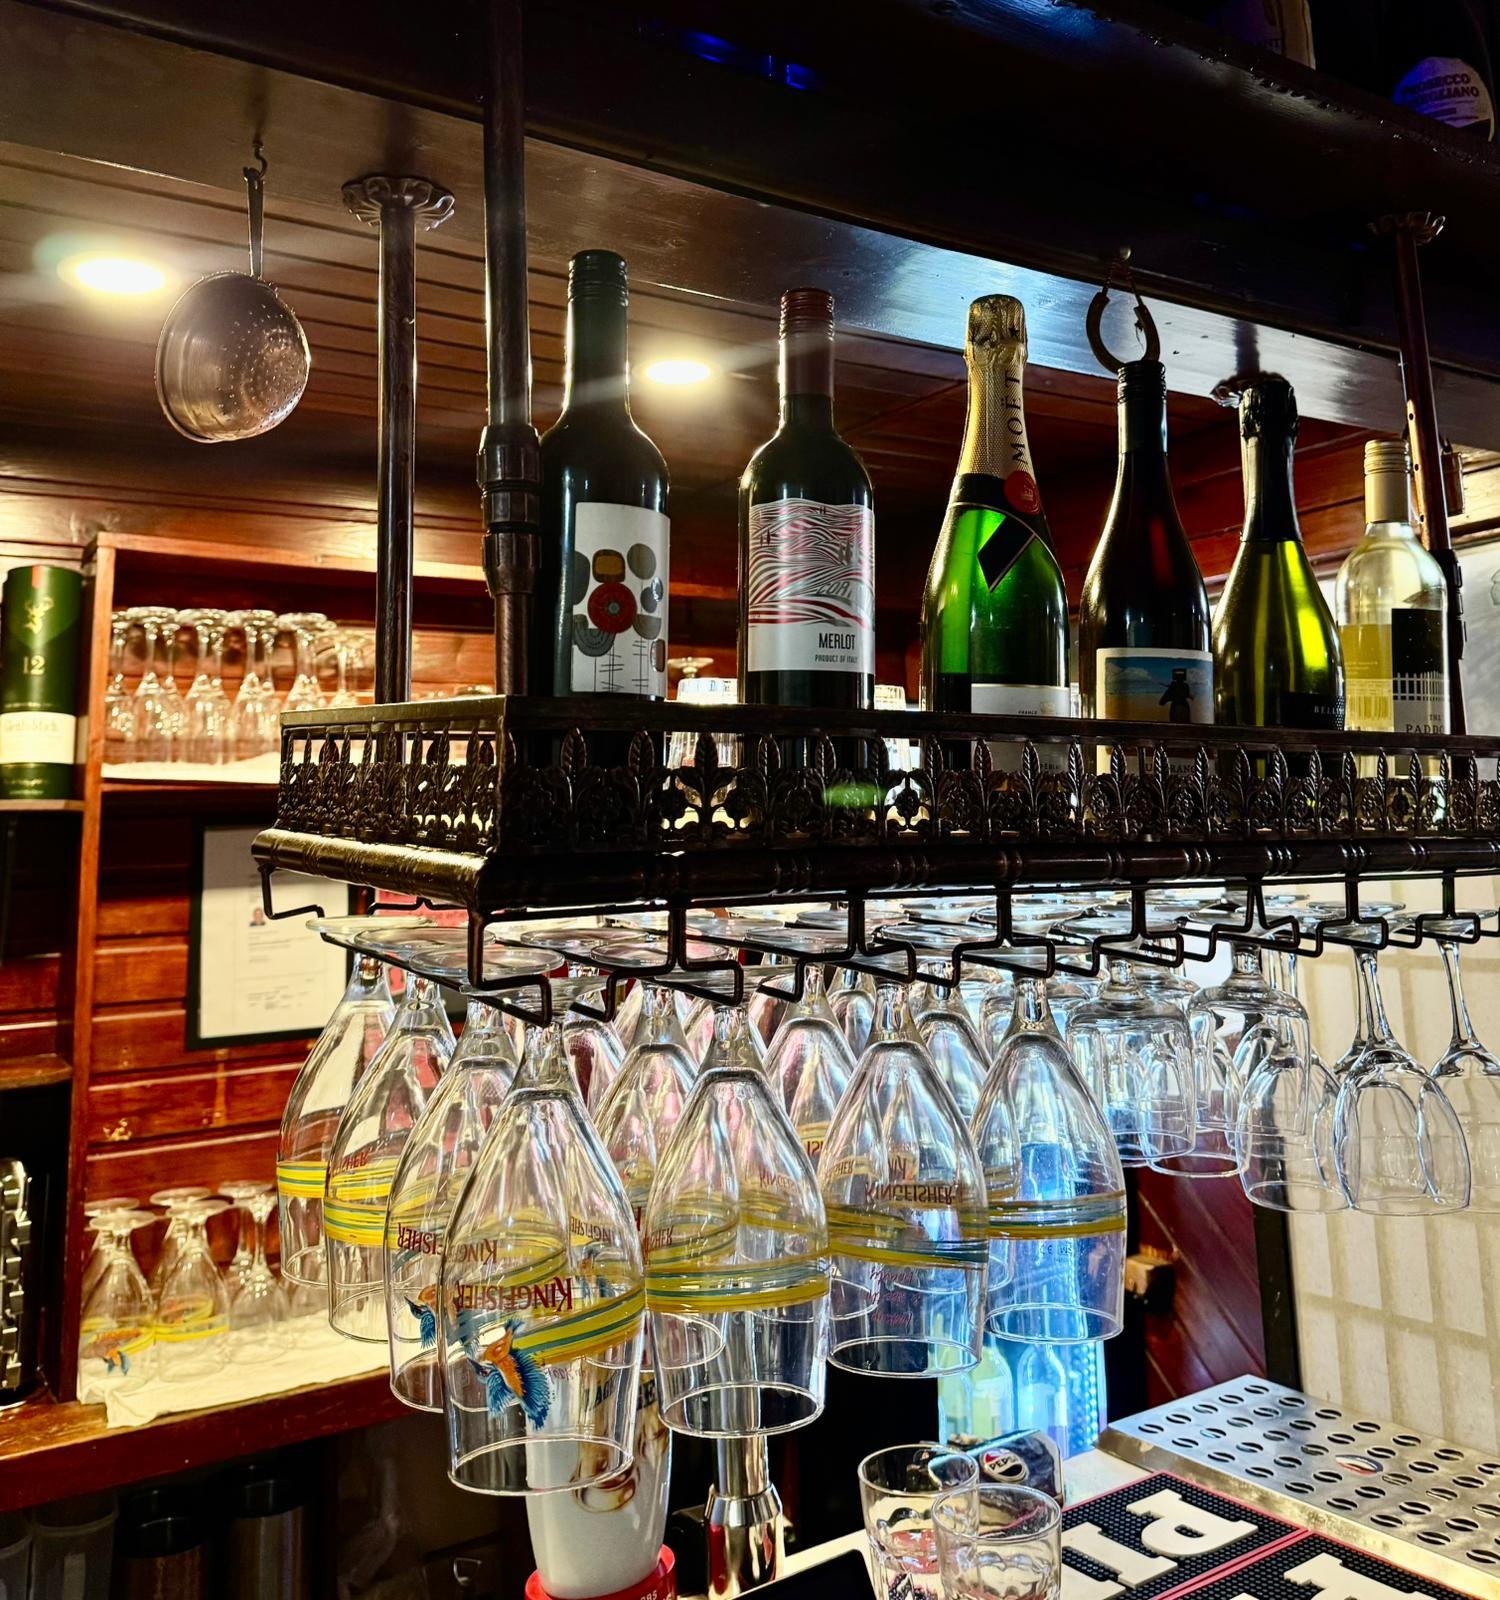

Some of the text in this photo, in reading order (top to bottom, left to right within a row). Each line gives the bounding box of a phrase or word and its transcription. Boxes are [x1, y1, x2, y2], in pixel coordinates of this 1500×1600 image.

[1002, 371, 1027, 464] MOËT
[819, 632, 856, 650] MERLOT
[23, 655, 46, 676] 12
[814, 654, 839, 663] PRODUCT
[839, 655, 846, 664] OF
[453, 1275, 573, 1313] KINGFISHER
